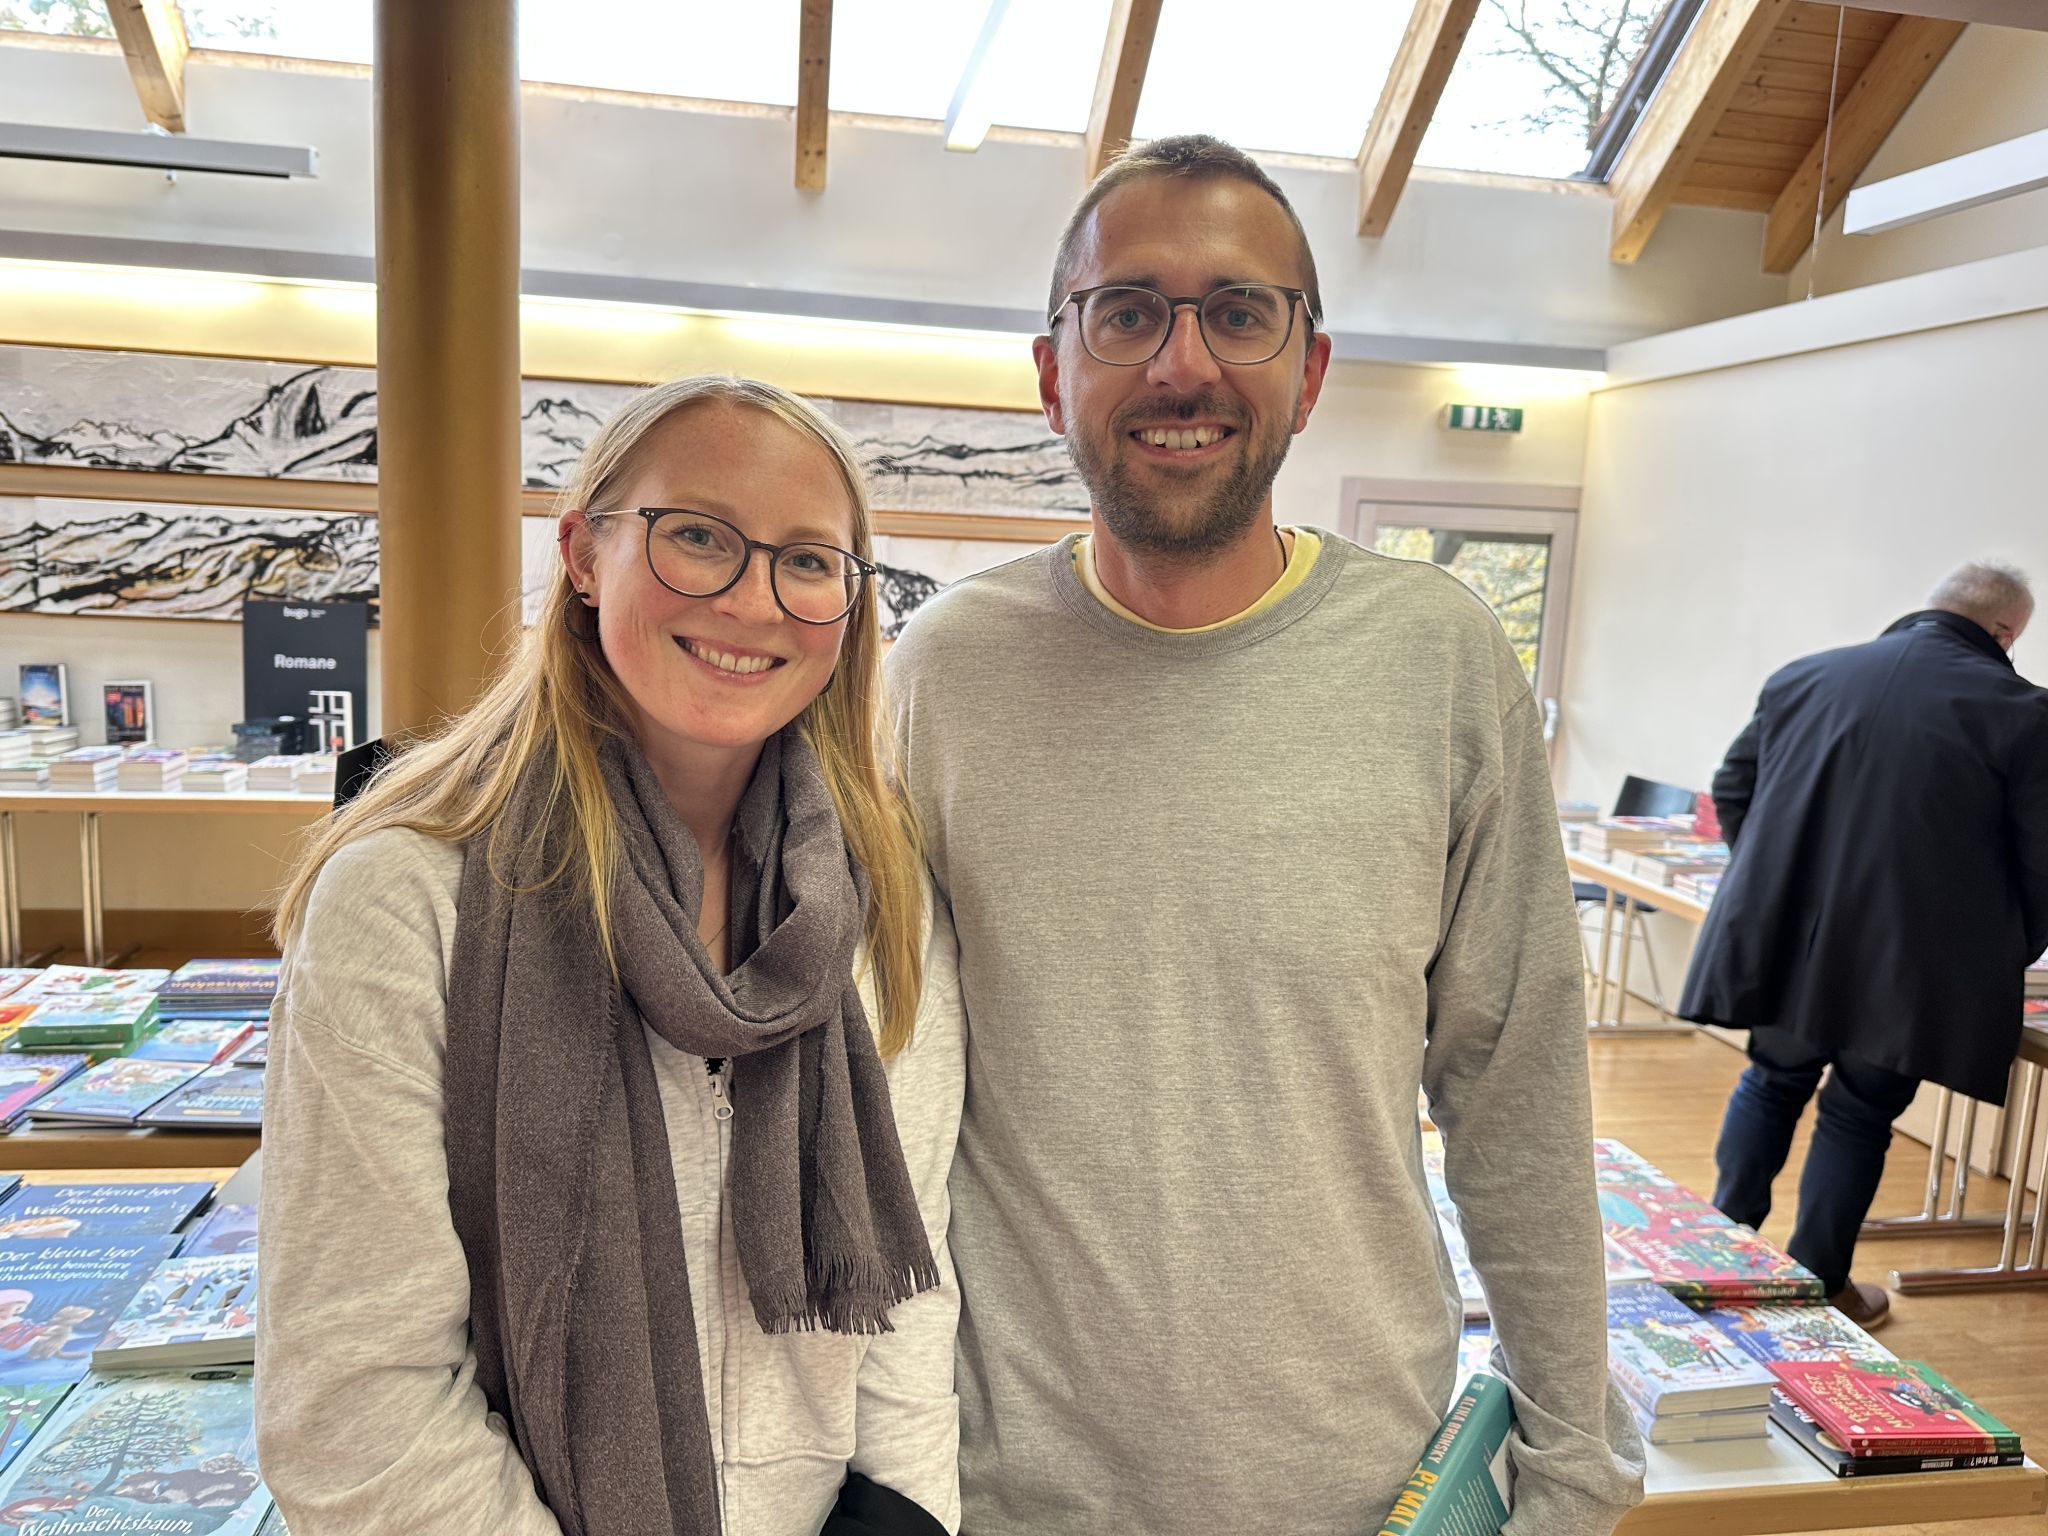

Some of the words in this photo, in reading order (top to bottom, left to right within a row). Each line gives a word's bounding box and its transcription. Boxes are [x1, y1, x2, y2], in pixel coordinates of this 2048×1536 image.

[274, 653, 337, 670] Romane
[54, 1188, 91, 1198] Der
[91, 1186, 146, 1198] kleine
[24, 1203, 151, 1215] Weihnachten
[0, 1251, 35, 1261] Der
[38, 1247, 101, 1259] kleine
[99, 1246, 146, 1261] Igel
[29, 1261, 60, 1270] das
[60, 1260, 131, 1270] besondere
[0, 1270, 129, 1282] hnachtsgeschenk
[1452, 1395, 1477, 1422] ALINA
[1428, 1421, 1462, 1464] BRONSKY
[1975, 1456, 1987, 1466] drei
[1986, 1455, 1998, 1465] Die
[1408, 1462, 1440, 1491] Pi
[85, 1505, 114, 1518] Der
[1384, 1489, 1427, 1527] MAL
[18, 1511, 194, 1536] Weihnachtsbaum,
